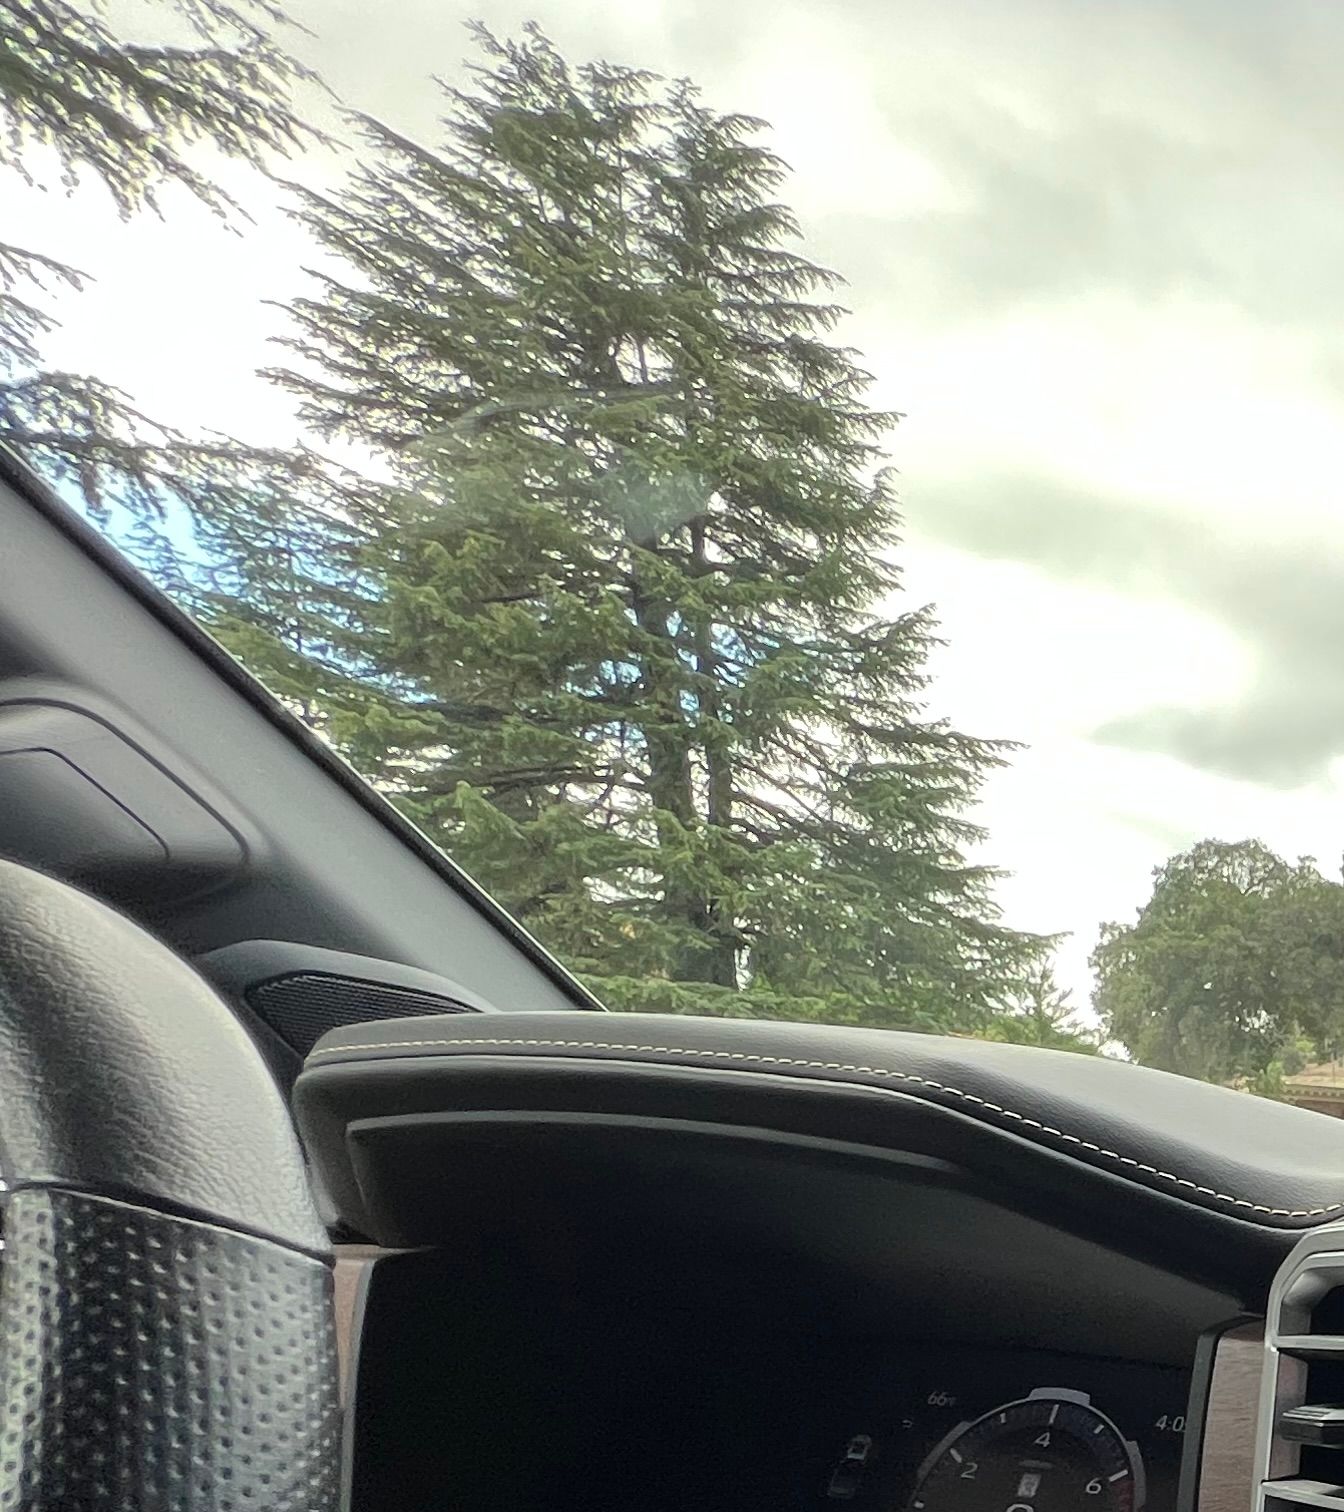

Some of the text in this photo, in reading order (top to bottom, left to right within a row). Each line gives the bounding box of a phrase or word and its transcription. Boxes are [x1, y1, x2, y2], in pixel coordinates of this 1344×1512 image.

[1155, 1414, 1187, 1433] 4:0
[1034, 1432, 1052, 1448] 4
[961, 1462, 979, 1480] 2
[1085, 1478, 1103, 1495] 6
